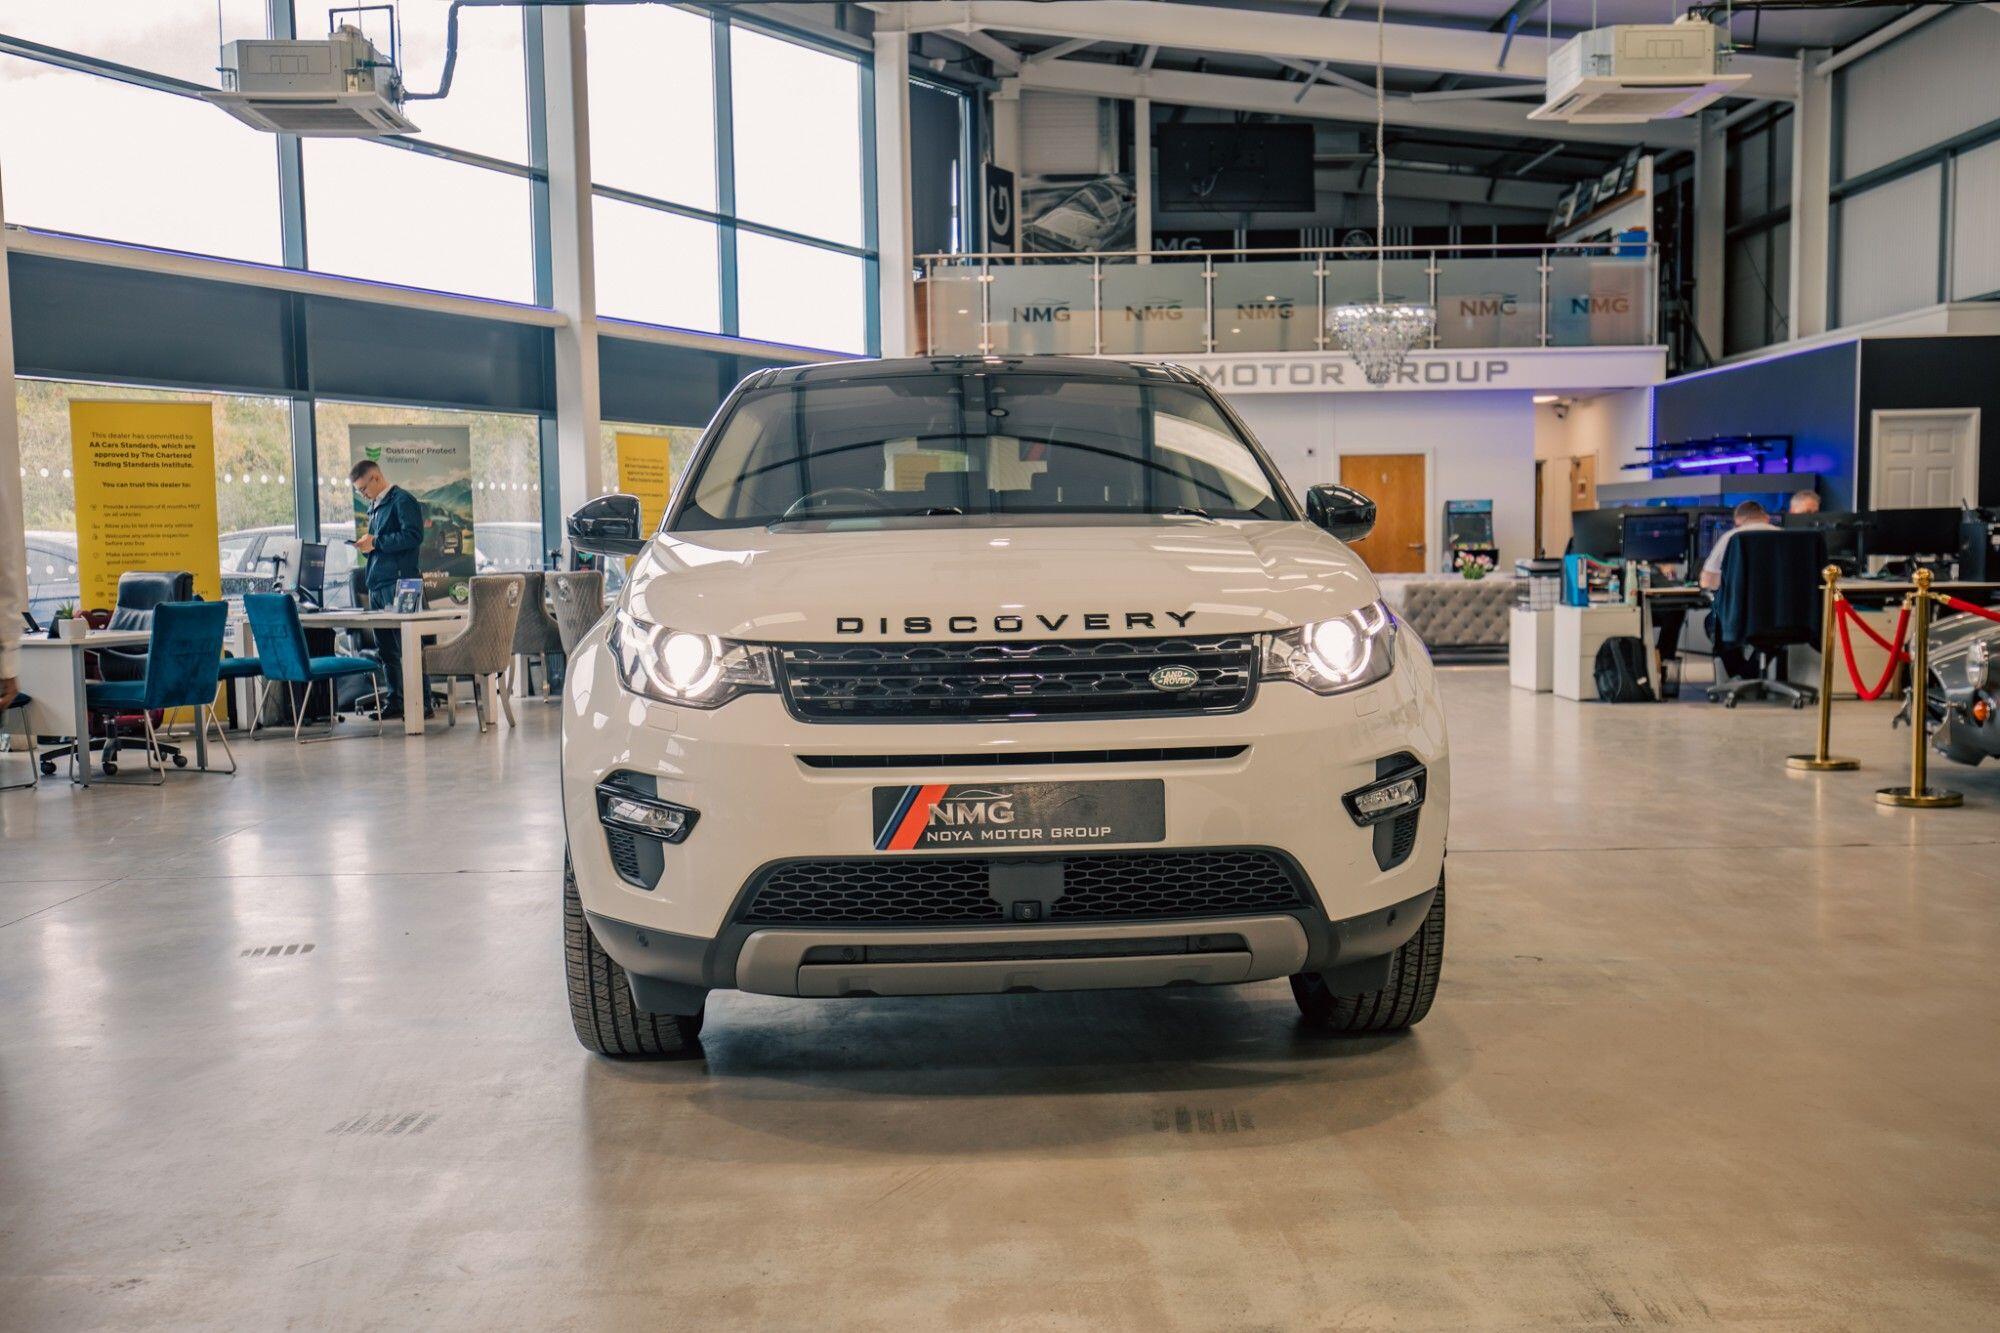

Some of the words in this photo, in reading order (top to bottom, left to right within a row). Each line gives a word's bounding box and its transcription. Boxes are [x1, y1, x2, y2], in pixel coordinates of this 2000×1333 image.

[1013, 306, 1070, 322] NMG
[1126, 305, 1183, 321] NMG
[1237, 304, 1294, 319] NMG
[1459, 300, 1517, 316] NMG
[1572, 298, 1629, 314] NMG
[1199, 362, 1344, 386] MOTOR
[1372, 360, 1509, 384] ROUP
[386, 447, 424, 455] Customer
[93, 461, 121, 469] Trading
[836, 611, 1196, 635] DISCOVERY
[1160, 670, 1183, 678] LAND
[1162, 677, 1191, 686] ROVER
[927, 801, 1015, 826] NMG
[926, 831, 974, 842] NOYA
[981, 828, 1043, 840] MOTOR
[1051, 826, 1113, 838] GROUP
